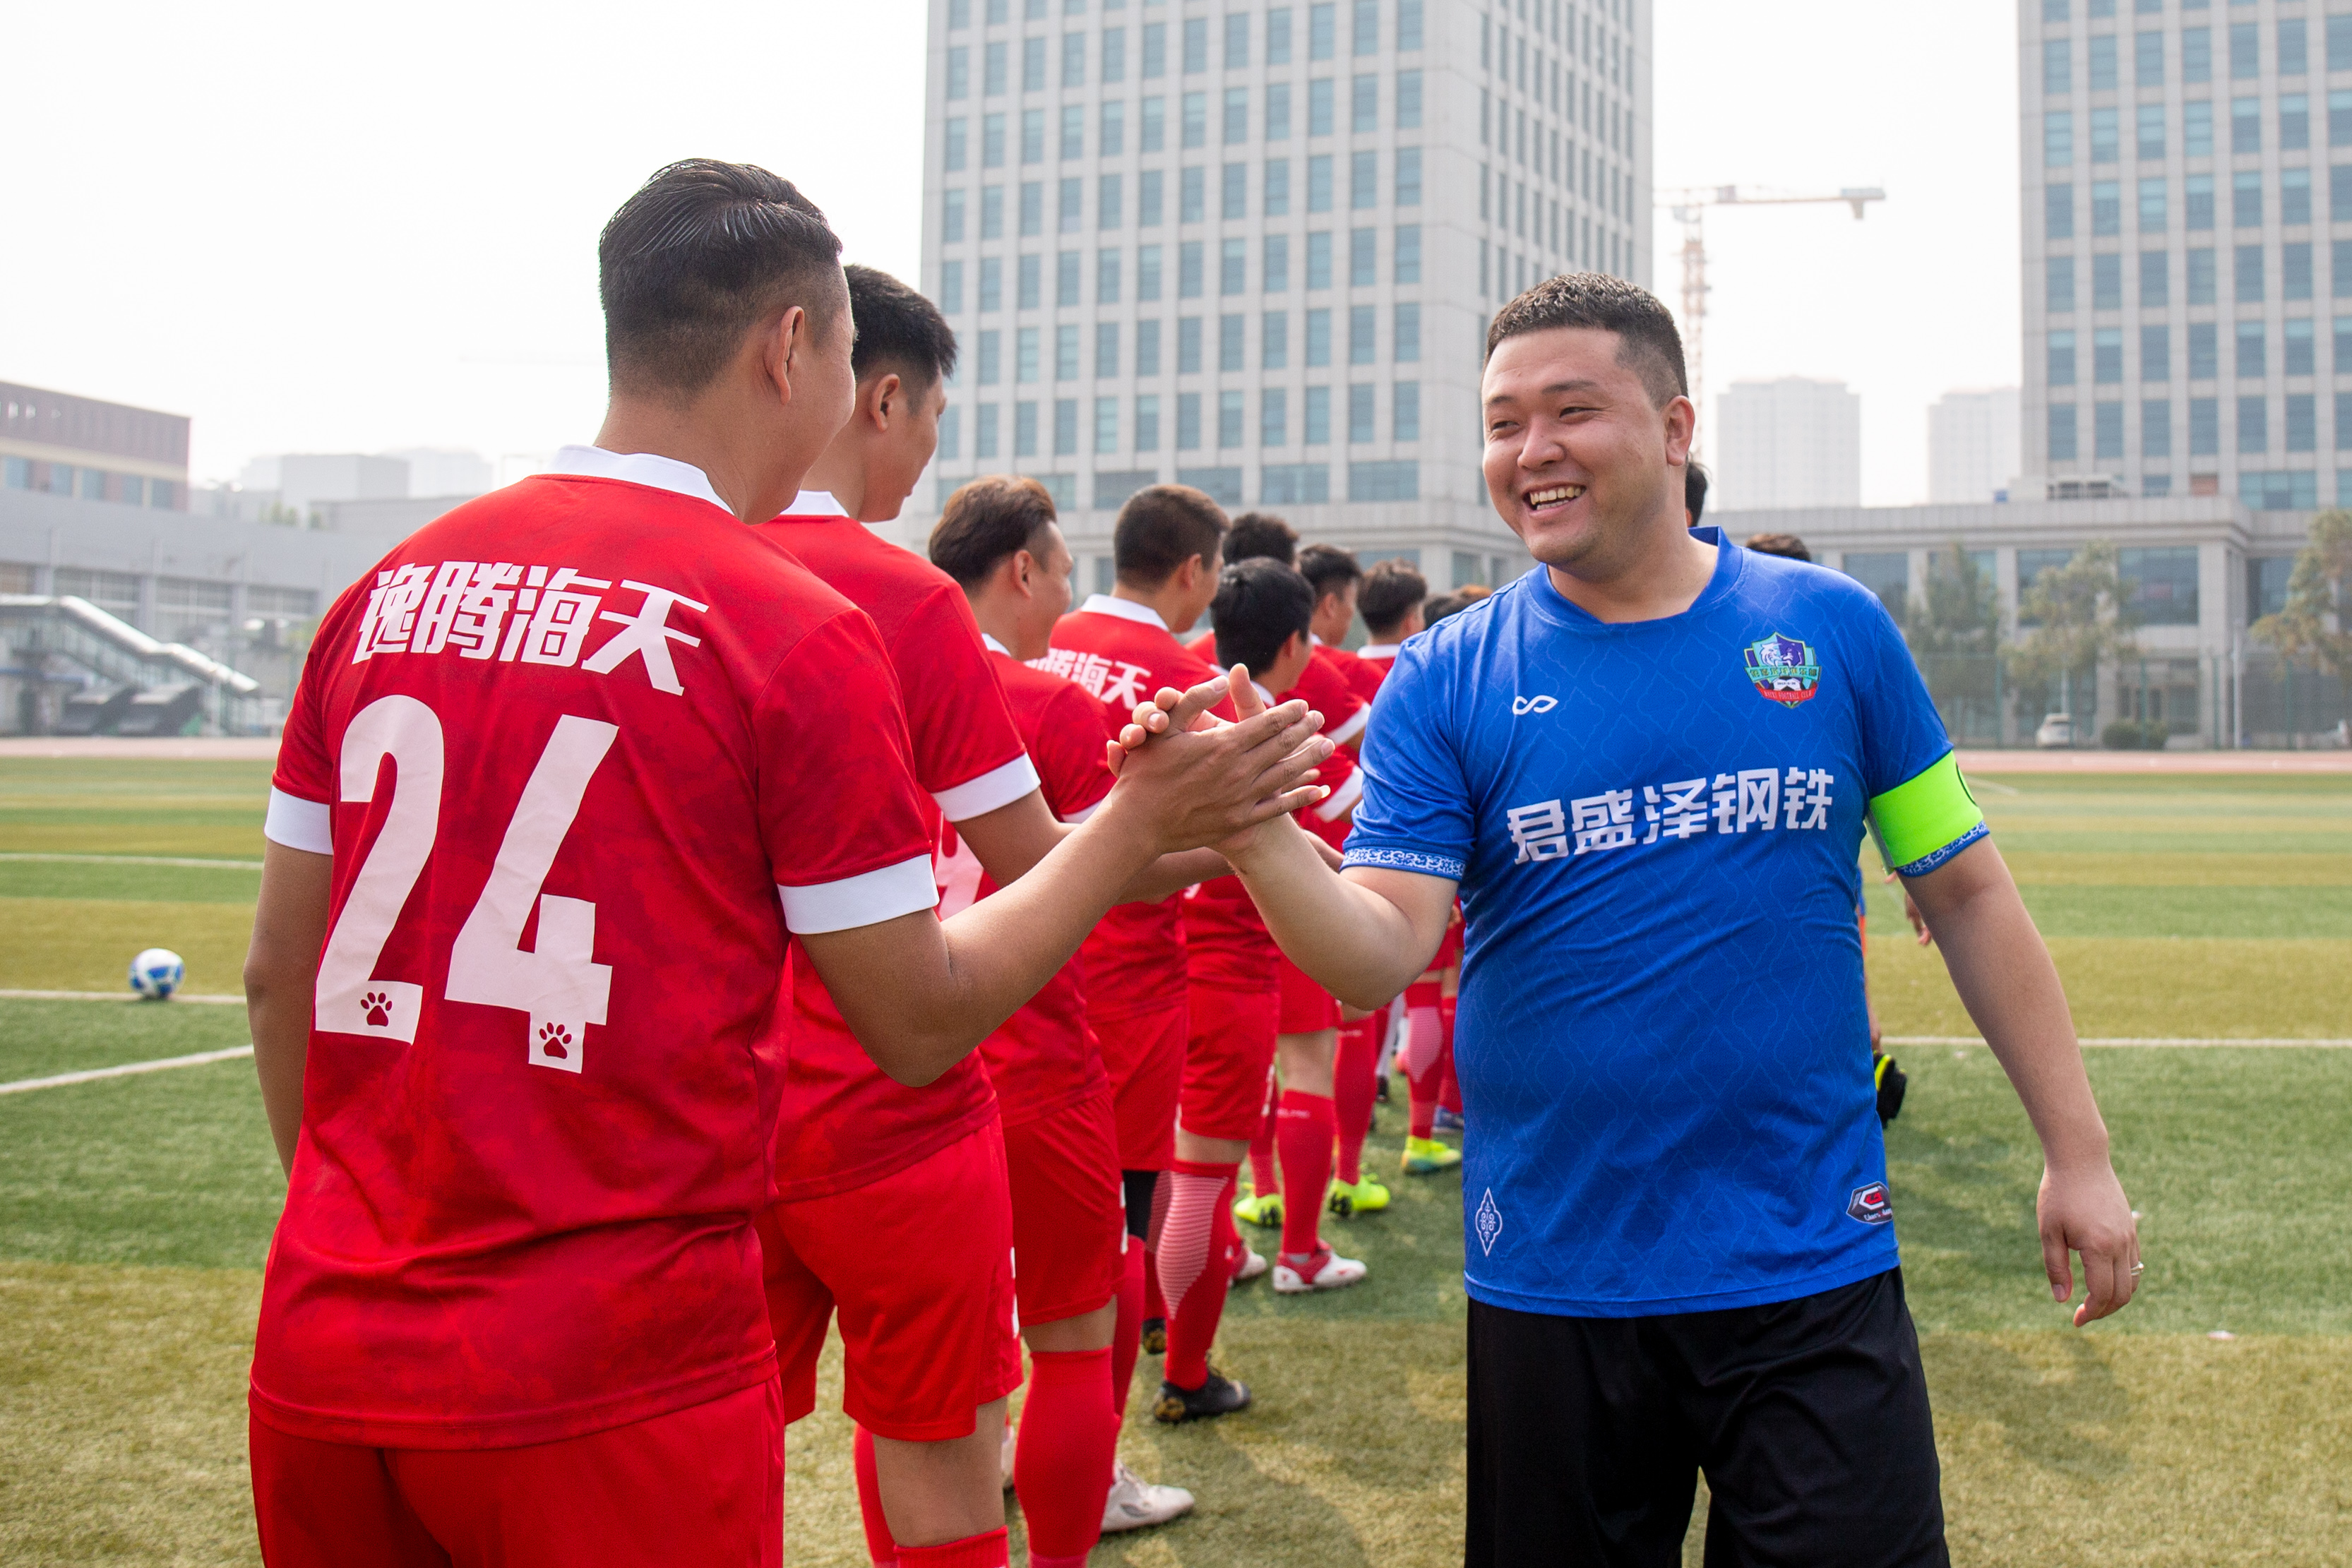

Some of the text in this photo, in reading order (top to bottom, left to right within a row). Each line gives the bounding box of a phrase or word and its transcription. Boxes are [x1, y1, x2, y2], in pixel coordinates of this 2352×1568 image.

[352, 561, 709, 696] 逸腾海天
[1023, 647, 1152, 711] 腾海天
[1507, 767, 1834, 865] 君盛泽钢铁
[316, 695, 619, 1074] 24
